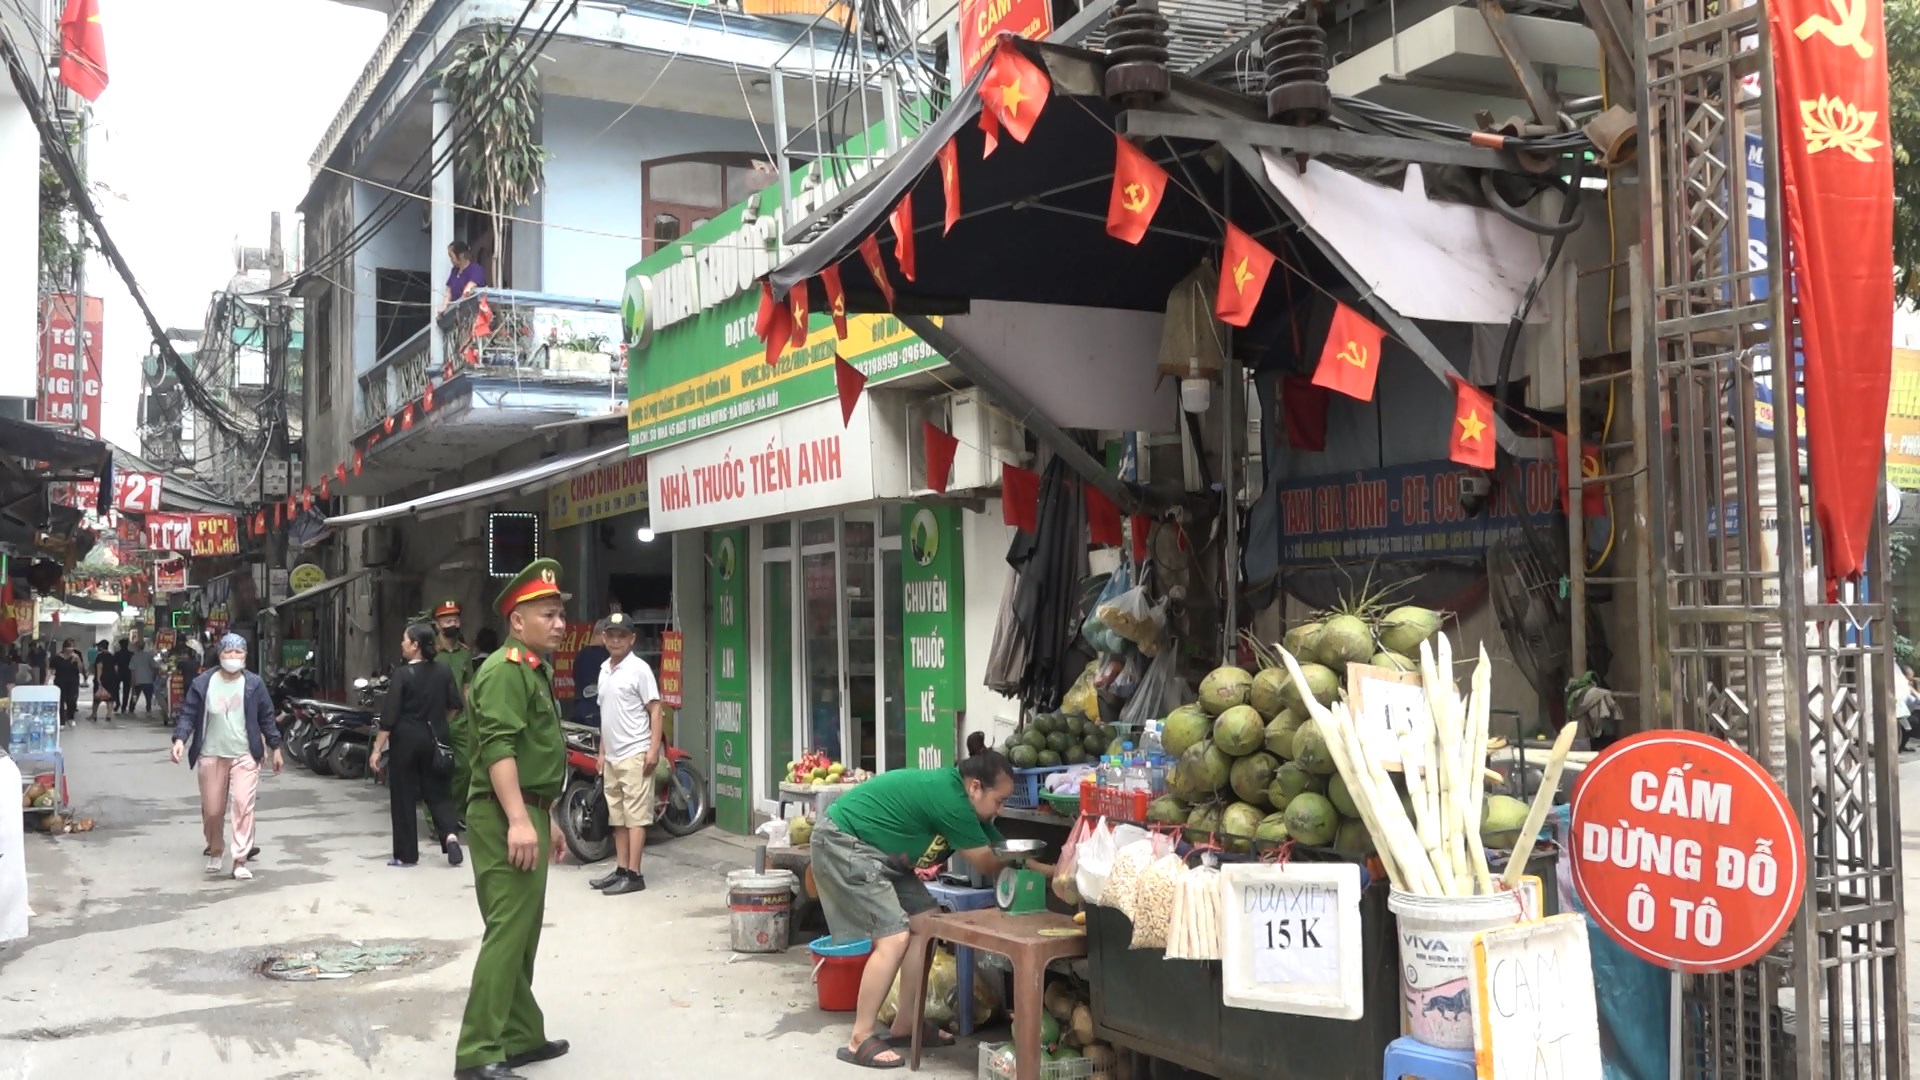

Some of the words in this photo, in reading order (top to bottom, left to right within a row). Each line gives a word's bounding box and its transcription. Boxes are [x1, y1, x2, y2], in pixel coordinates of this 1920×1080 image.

[124, 474, 162, 511] 21
[659, 465, 691, 512] NHÀ
[693, 445, 745, 505] THUỐC
[750, 435, 792, 495] TIẾN
[798, 435, 842, 486] ANH
[1316, 485, 1343, 534] GIA
[1345, 471, 1387, 529] ĐÌNH
[904, 575, 947, 613] CHUYÊN
[910, 626, 945, 669] THUỐC
[920, 685, 936, 723] KÊ
[1630, 762, 1733, 825] CẤM
[1582, 818, 1702, 882] DỪNG
[1715, 837, 1778, 897] ĐỖ
[1265, 919, 1292, 950] 15
[1300, 917, 1324, 949] K
[1627, 883, 1656, 932] Ô
[1669, 896, 1723, 947] TÔ
[1403, 933, 1449, 952] VIVA
